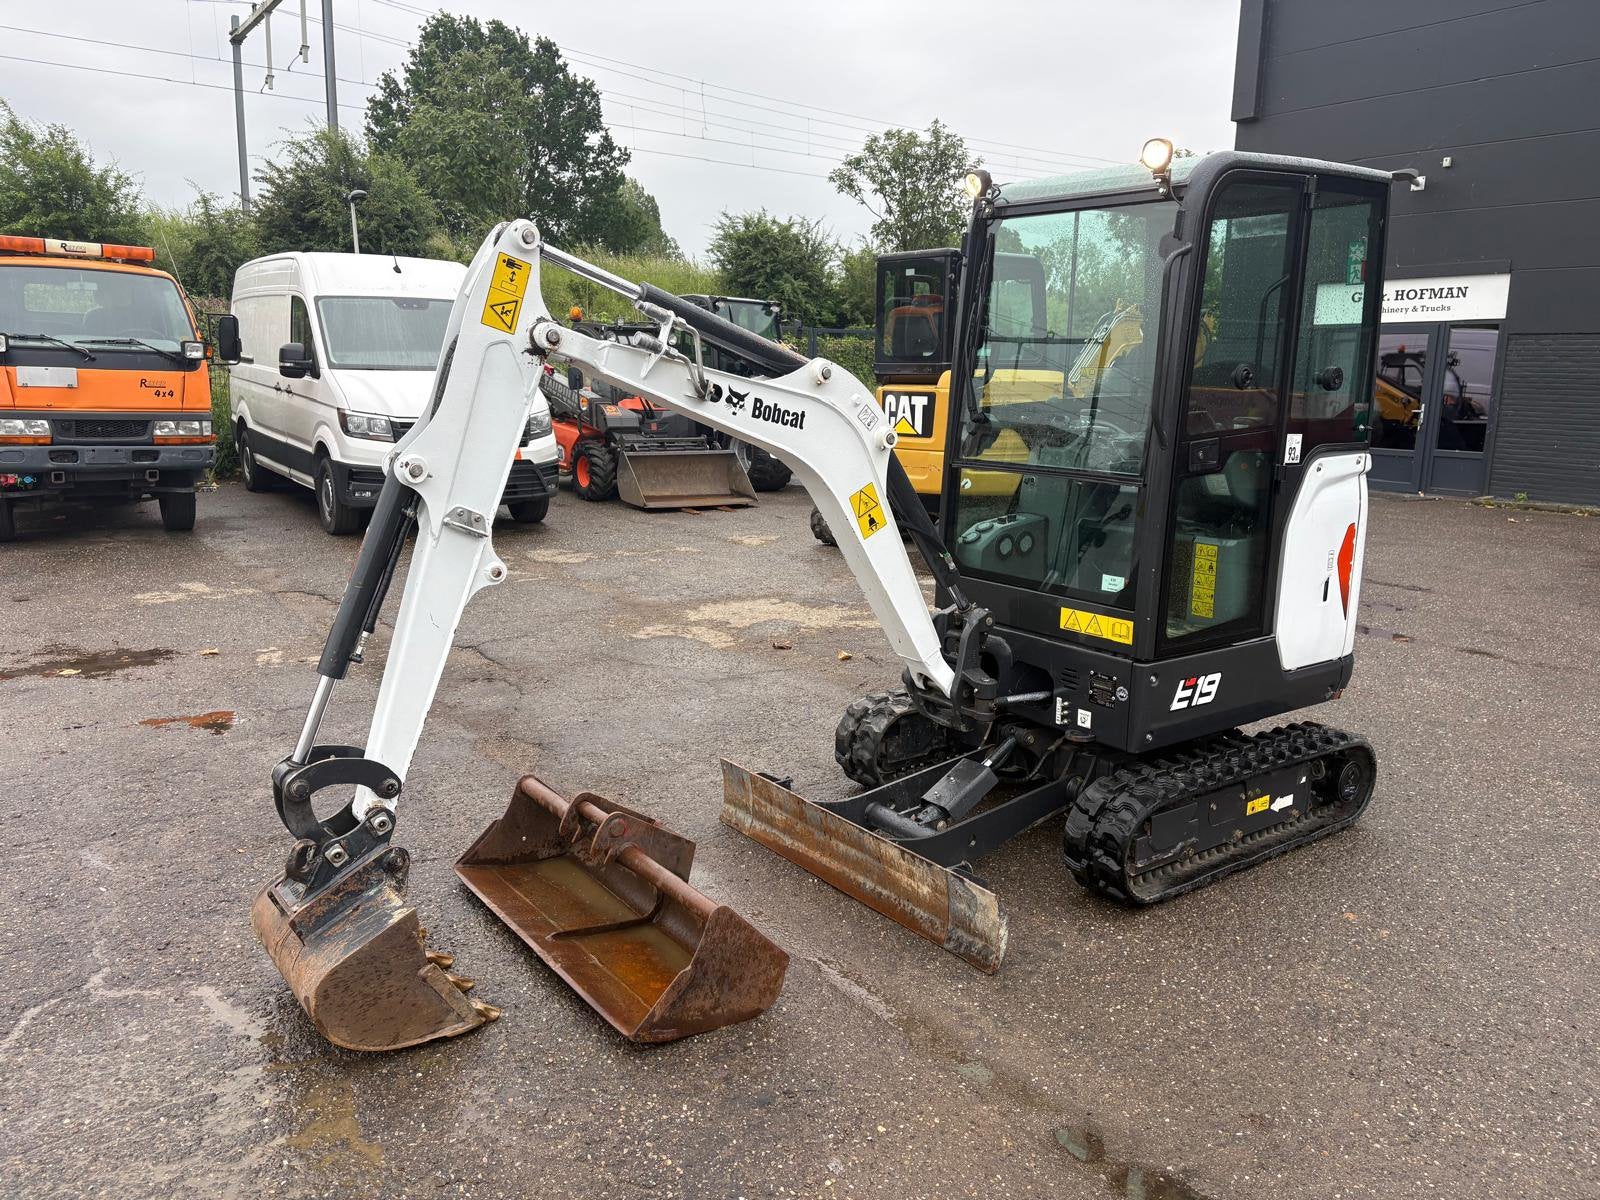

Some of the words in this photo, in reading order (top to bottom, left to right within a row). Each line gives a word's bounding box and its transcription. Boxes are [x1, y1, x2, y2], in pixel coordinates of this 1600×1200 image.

[1394, 286, 1469, 301] HOFMAN
[1411, 305, 1419, 313] &
[1420, 304, 1451, 312] Trucks
[751, 397, 806, 430] Bobcat
[884, 394, 928, 435] CAT
[1288, 446, 1297, 461] 93
[1169, 672, 1222, 711] E19
